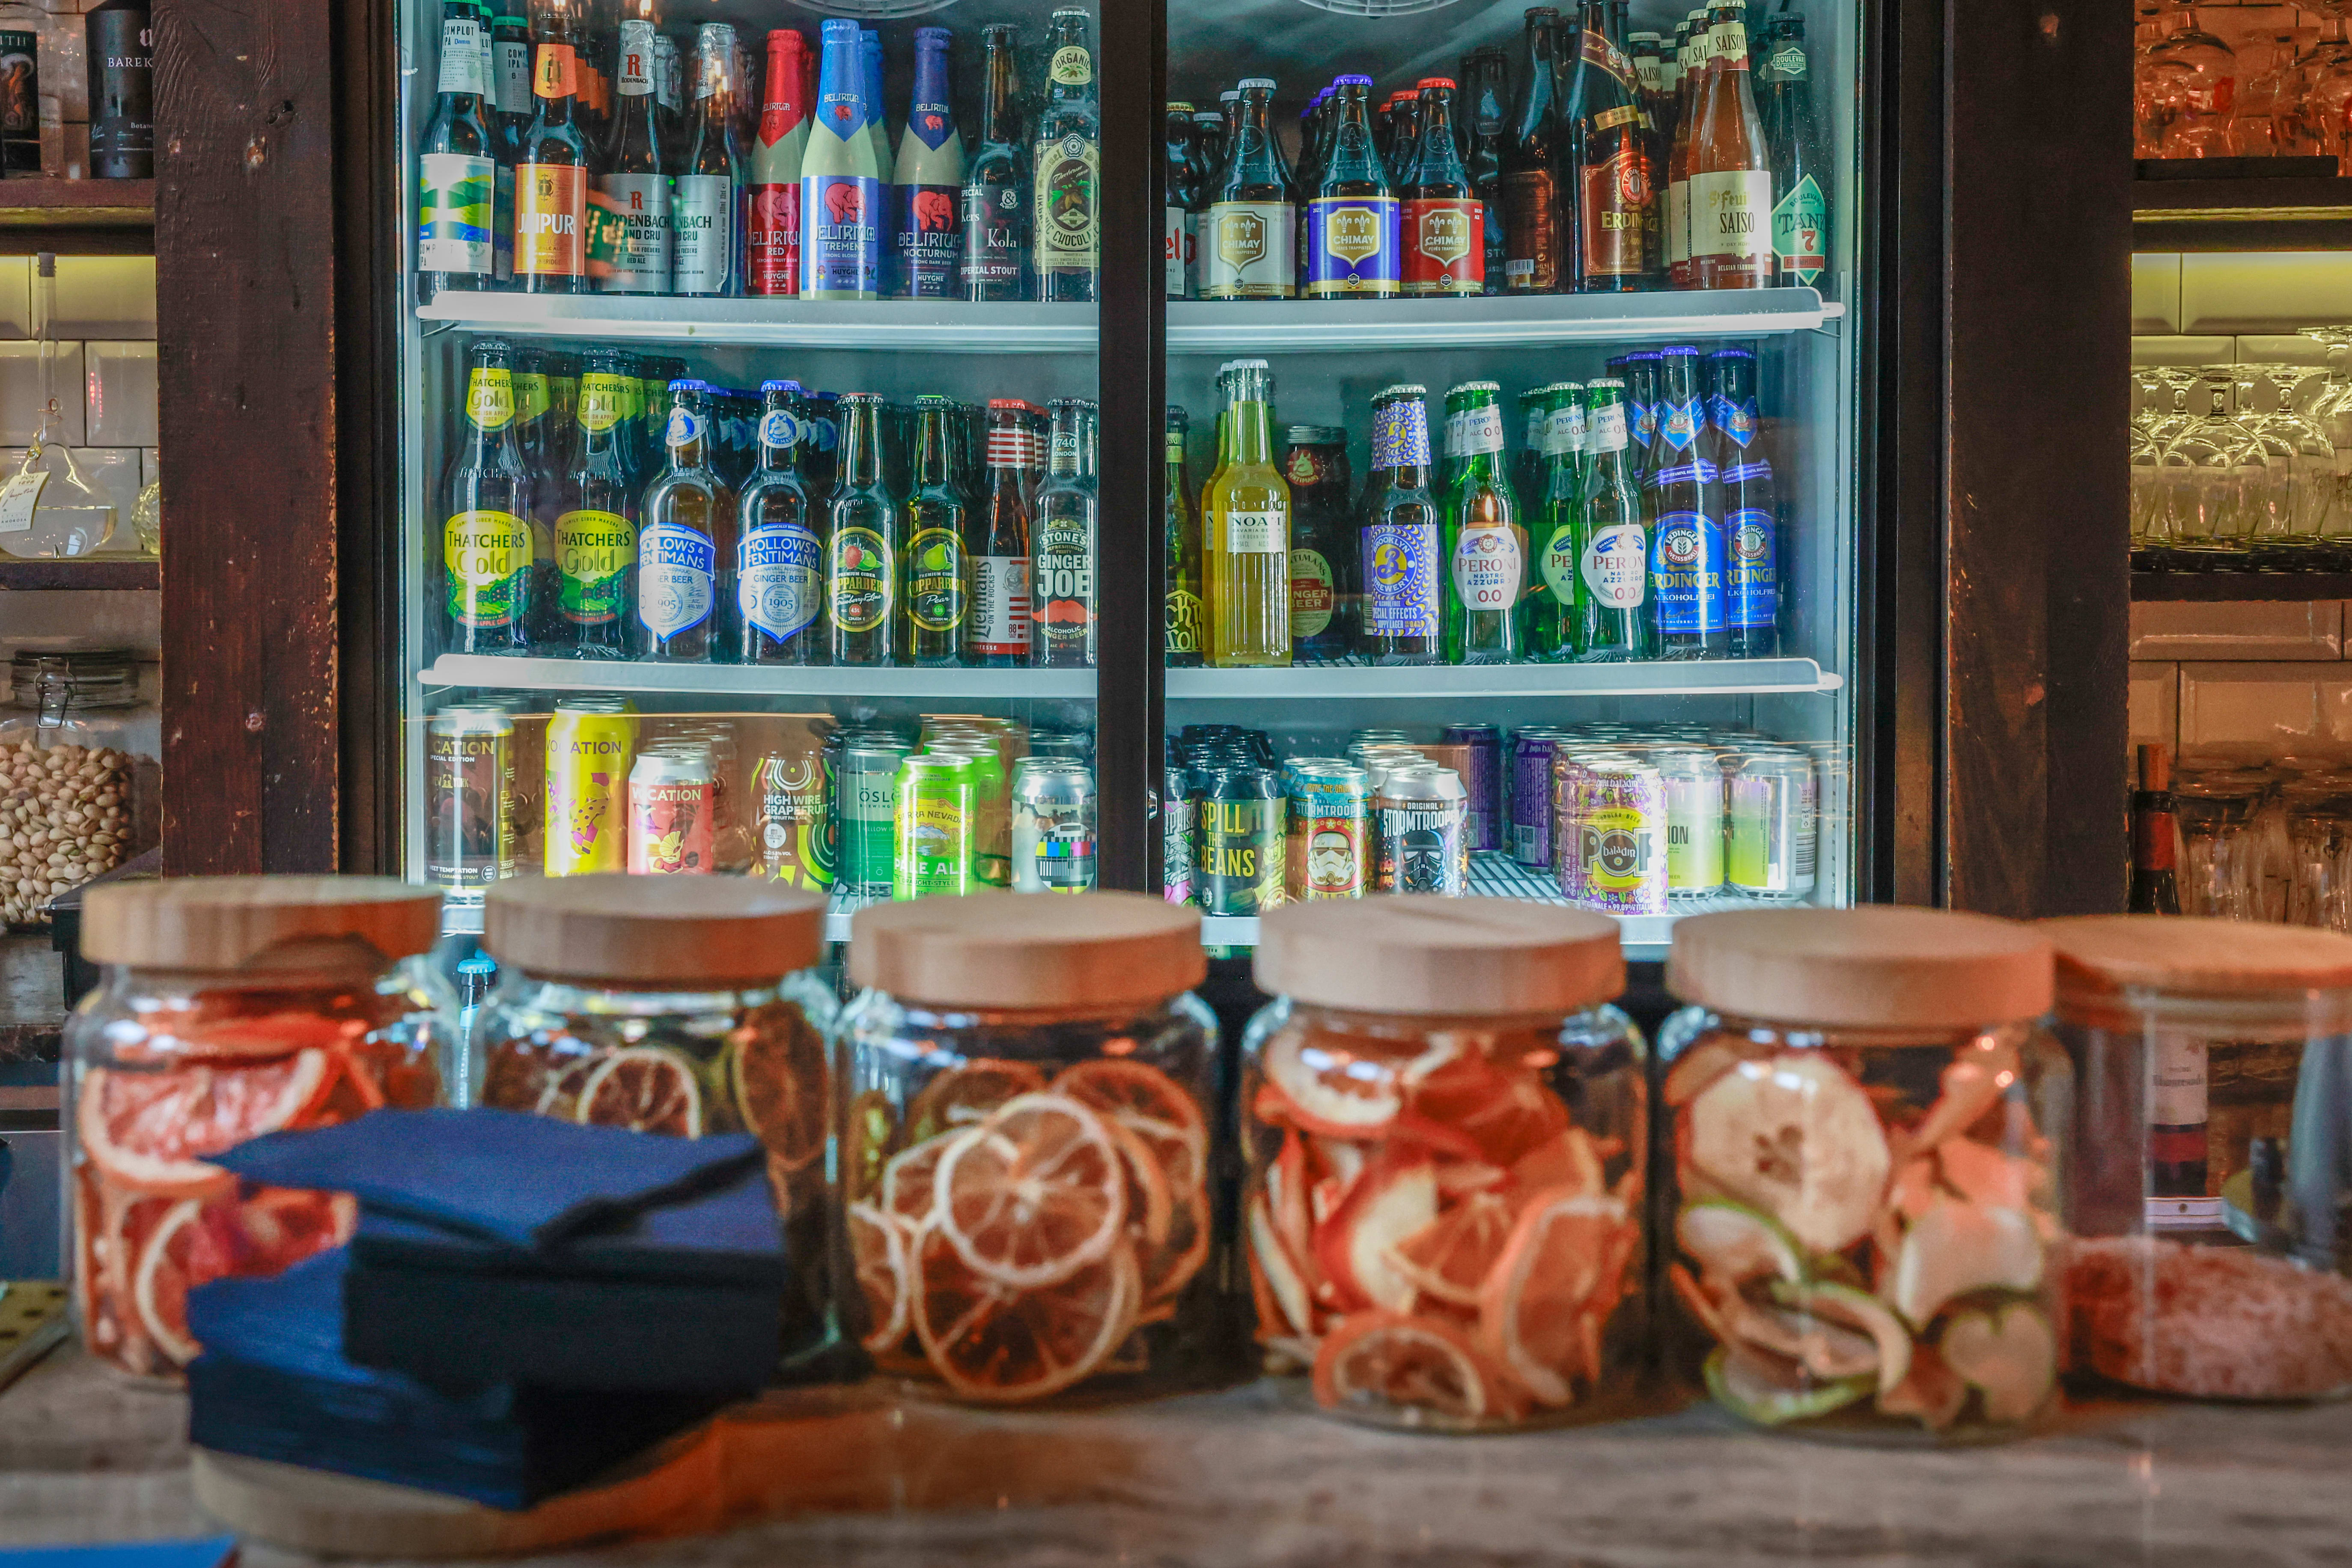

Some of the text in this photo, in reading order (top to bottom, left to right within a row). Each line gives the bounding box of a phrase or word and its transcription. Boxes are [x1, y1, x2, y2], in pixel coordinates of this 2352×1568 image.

[444, 26, 473, 36] COMPLOT
[443, 37, 451, 45] IPA
[1716, 34, 1745, 52] SAISON
[509, 60, 520, 68] IPA
[626, 54, 641, 76] R
[1056, 53, 1089, 70] ORGANIC
[630, 191, 643, 210] R
[1789, 192, 1822, 207] BOULEVARD
[962, 204, 980, 222] Kers
[1720, 212, 1754, 234] SAISO
[1778, 213, 1825, 235] TANK
[644, 230, 660, 240] CRU
[683, 231, 697, 241] CRU
[987, 228, 1016, 247] Kola
[1333, 235, 1375, 244] CHIMAY
[1425, 236, 1466, 247] CHIMAY
[1801, 230, 1816, 252] 7
[825, 242, 865, 251] TREMENS
[1222, 239, 1261, 249] CHIMAY
[767, 247, 784, 256] RED
[903, 249, 958, 259] NOCTURNUM
[991, 266, 1017, 275] STOUT
[470, 377, 512, 388] THATCHERS
[470, 390, 509, 409] Gold
[580, 393, 616, 413] Gold
[1556, 414, 1583, 425] PERONI
[1052, 438, 1077, 448] 1740
[494, 519, 514, 529] MAKERS
[598, 518, 619, 529] MAKERS
[448, 531, 525, 548] THATCHERS
[557, 530, 630, 547] THATCHERS
[1041, 532, 1087, 545] STONE'S
[1665, 530, 1698, 544] ERDINGER
[1736, 526, 1765, 541] ERDINGER
[641, 538, 695, 554] HOLLOWS
[748, 538, 810, 553] HOLLOWS
[1046, 544, 1084, 553] REFRESHINGLY
[1373, 537, 1410, 553] BROOKLYN
[456, 550, 511, 575] Gold
[566, 549, 615, 575] Gold
[641, 551, 705, 569] FENTIMANS
[748, 551, 816, 569] FENTIMANS
[1037, 555, 1092, 569] GINGER
[1458, 558, 1516, 572] PERONI
[672, 575, 693, 584] BEER
[753, 574, 808, 583] GINGER BEER
[1037, 570, 1092, 598] JOE
[1375, 574, 1410, 592] BREWERY
[1648, 571, 1721, 589] ERDINGER
[926, 595, 950, 605] Pear
[972, 561, 991, 640] Liefmans
[1477, 589, 1502, 603] 0.0
[769, 598, 793, 610] 1905
[988, 613, 994, 624] ON
[1389, 607, 1417, 619] EFFECTS
[497, 616, 510, 625] CIDER
[1390, 620, 1403, 628] LAGER
[1009, 624, 1017, 633] 88
[1041, 628, 1087, 640] GINGER BEER
[1047, 626, 1081, 634] ALCOHOLIC
[1323, 784, 1333, 793] THE
[764, 794, 821, 805] HIGH WIRE
[763, 804, 828, 815] GRAPEFRUIT
[1296, 803, 1366, 817] STORMTROOPER
[897, 810, 963, 824] SIRRA NEVADA
[1201, 800, 1245, 834] SPILL
[1626, 814, 1640, 824] BEER
[1208, 831, 1222, 847] THE
[1603, 846, 1636, 857] baladin
[894, 857, 968, 875] PALE ALE
[1201, 848, 1255, 878] BEANS
